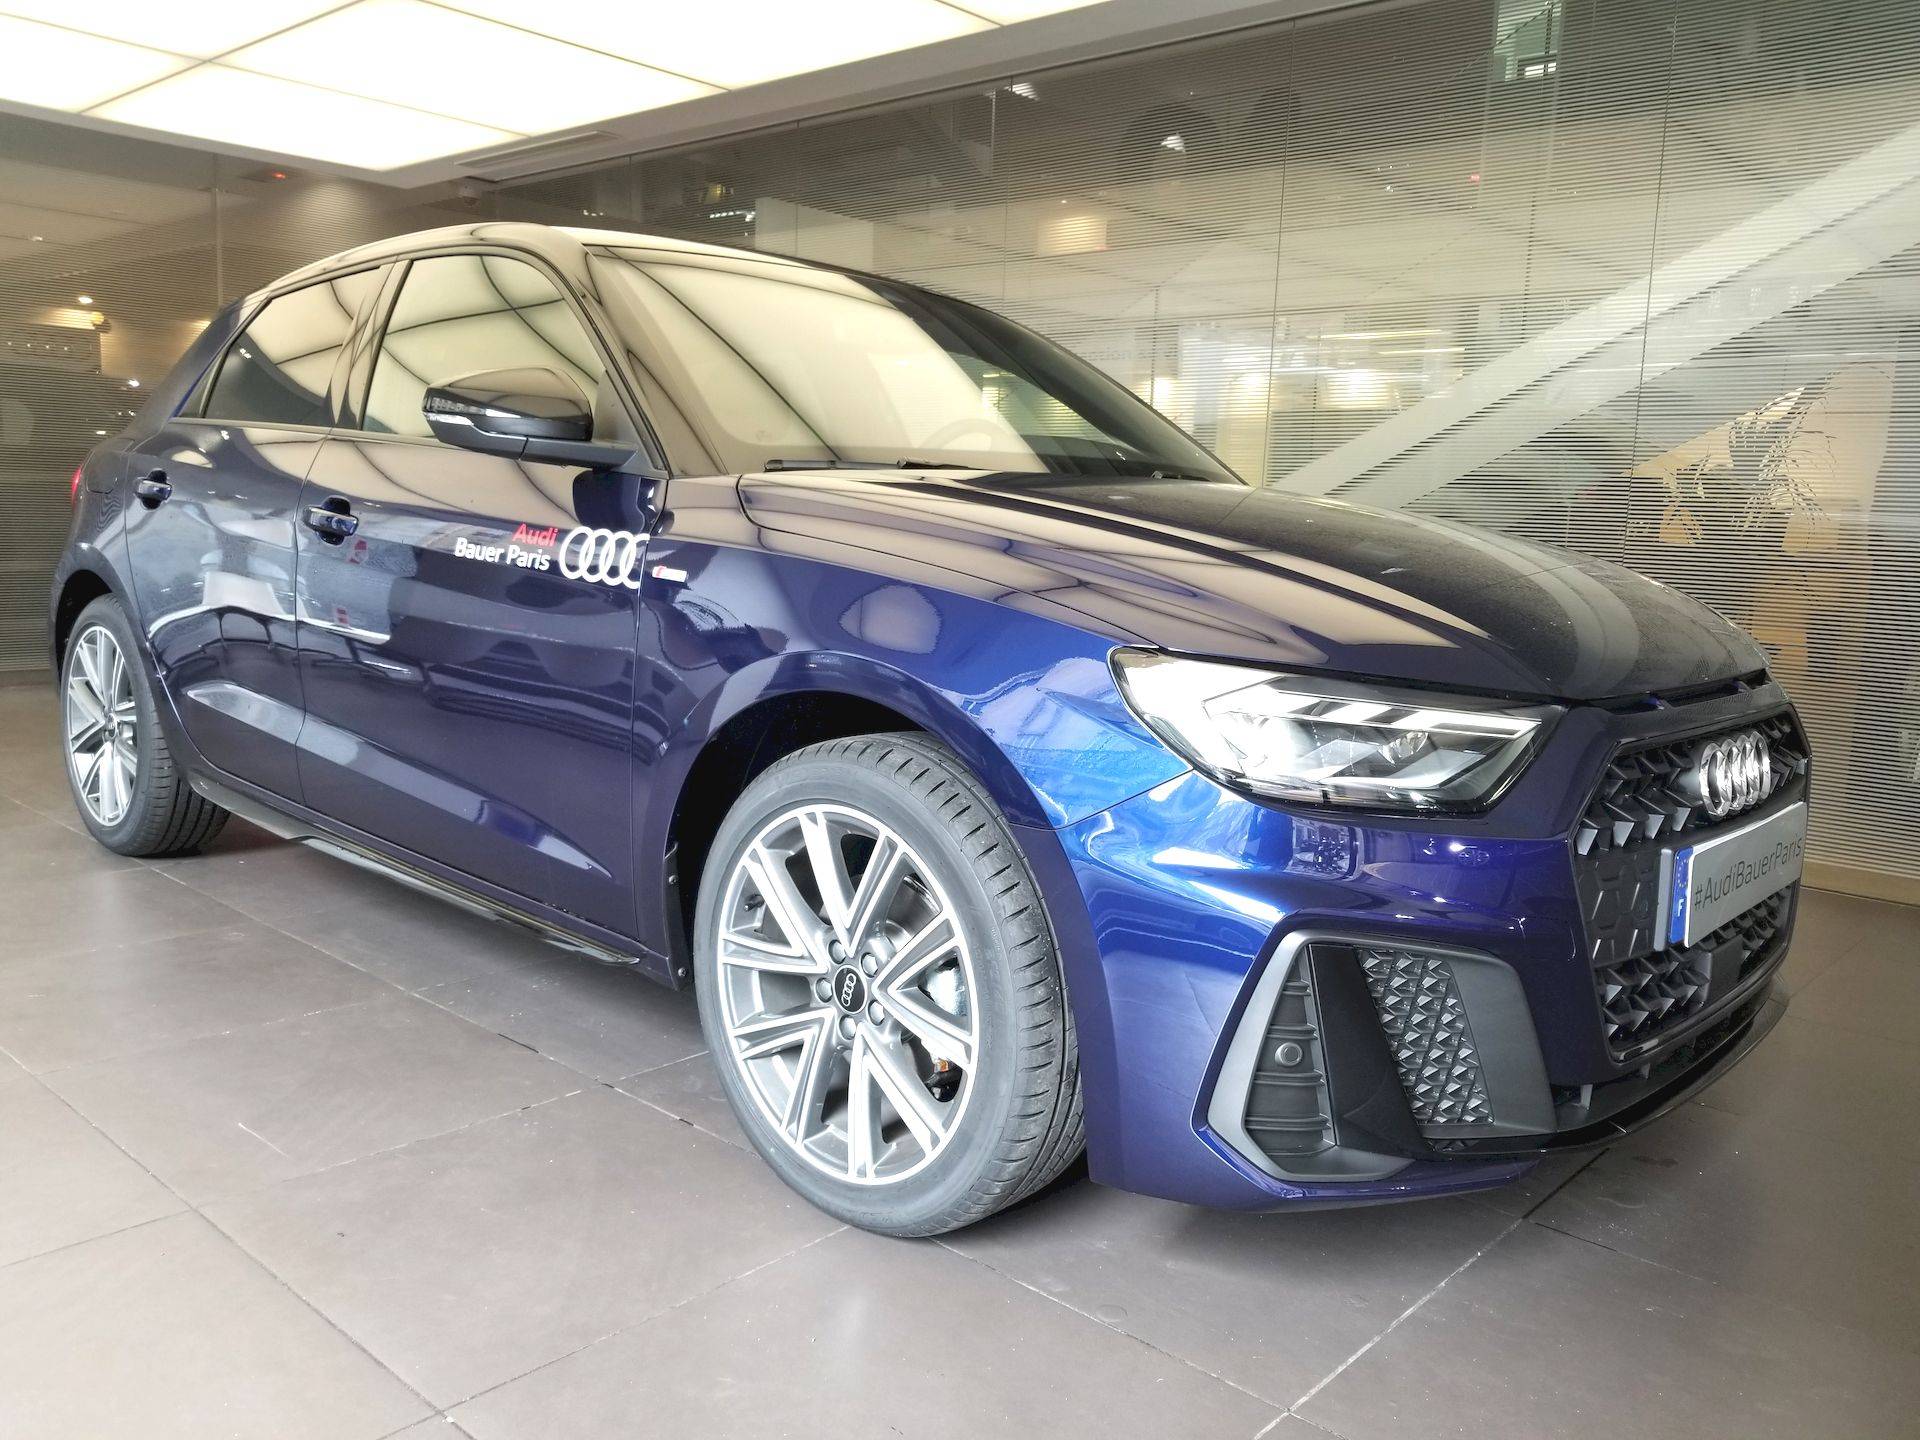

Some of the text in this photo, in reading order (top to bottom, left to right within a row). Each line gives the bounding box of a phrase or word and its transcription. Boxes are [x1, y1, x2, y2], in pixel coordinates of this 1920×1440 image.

[512, 523, 559, 547] Audi
[454, 536, 552, 571] Bauer Paris
[1694, 834, 1802, 912] #AudiBauerParis
[1676, 897, 1685, 917] F
